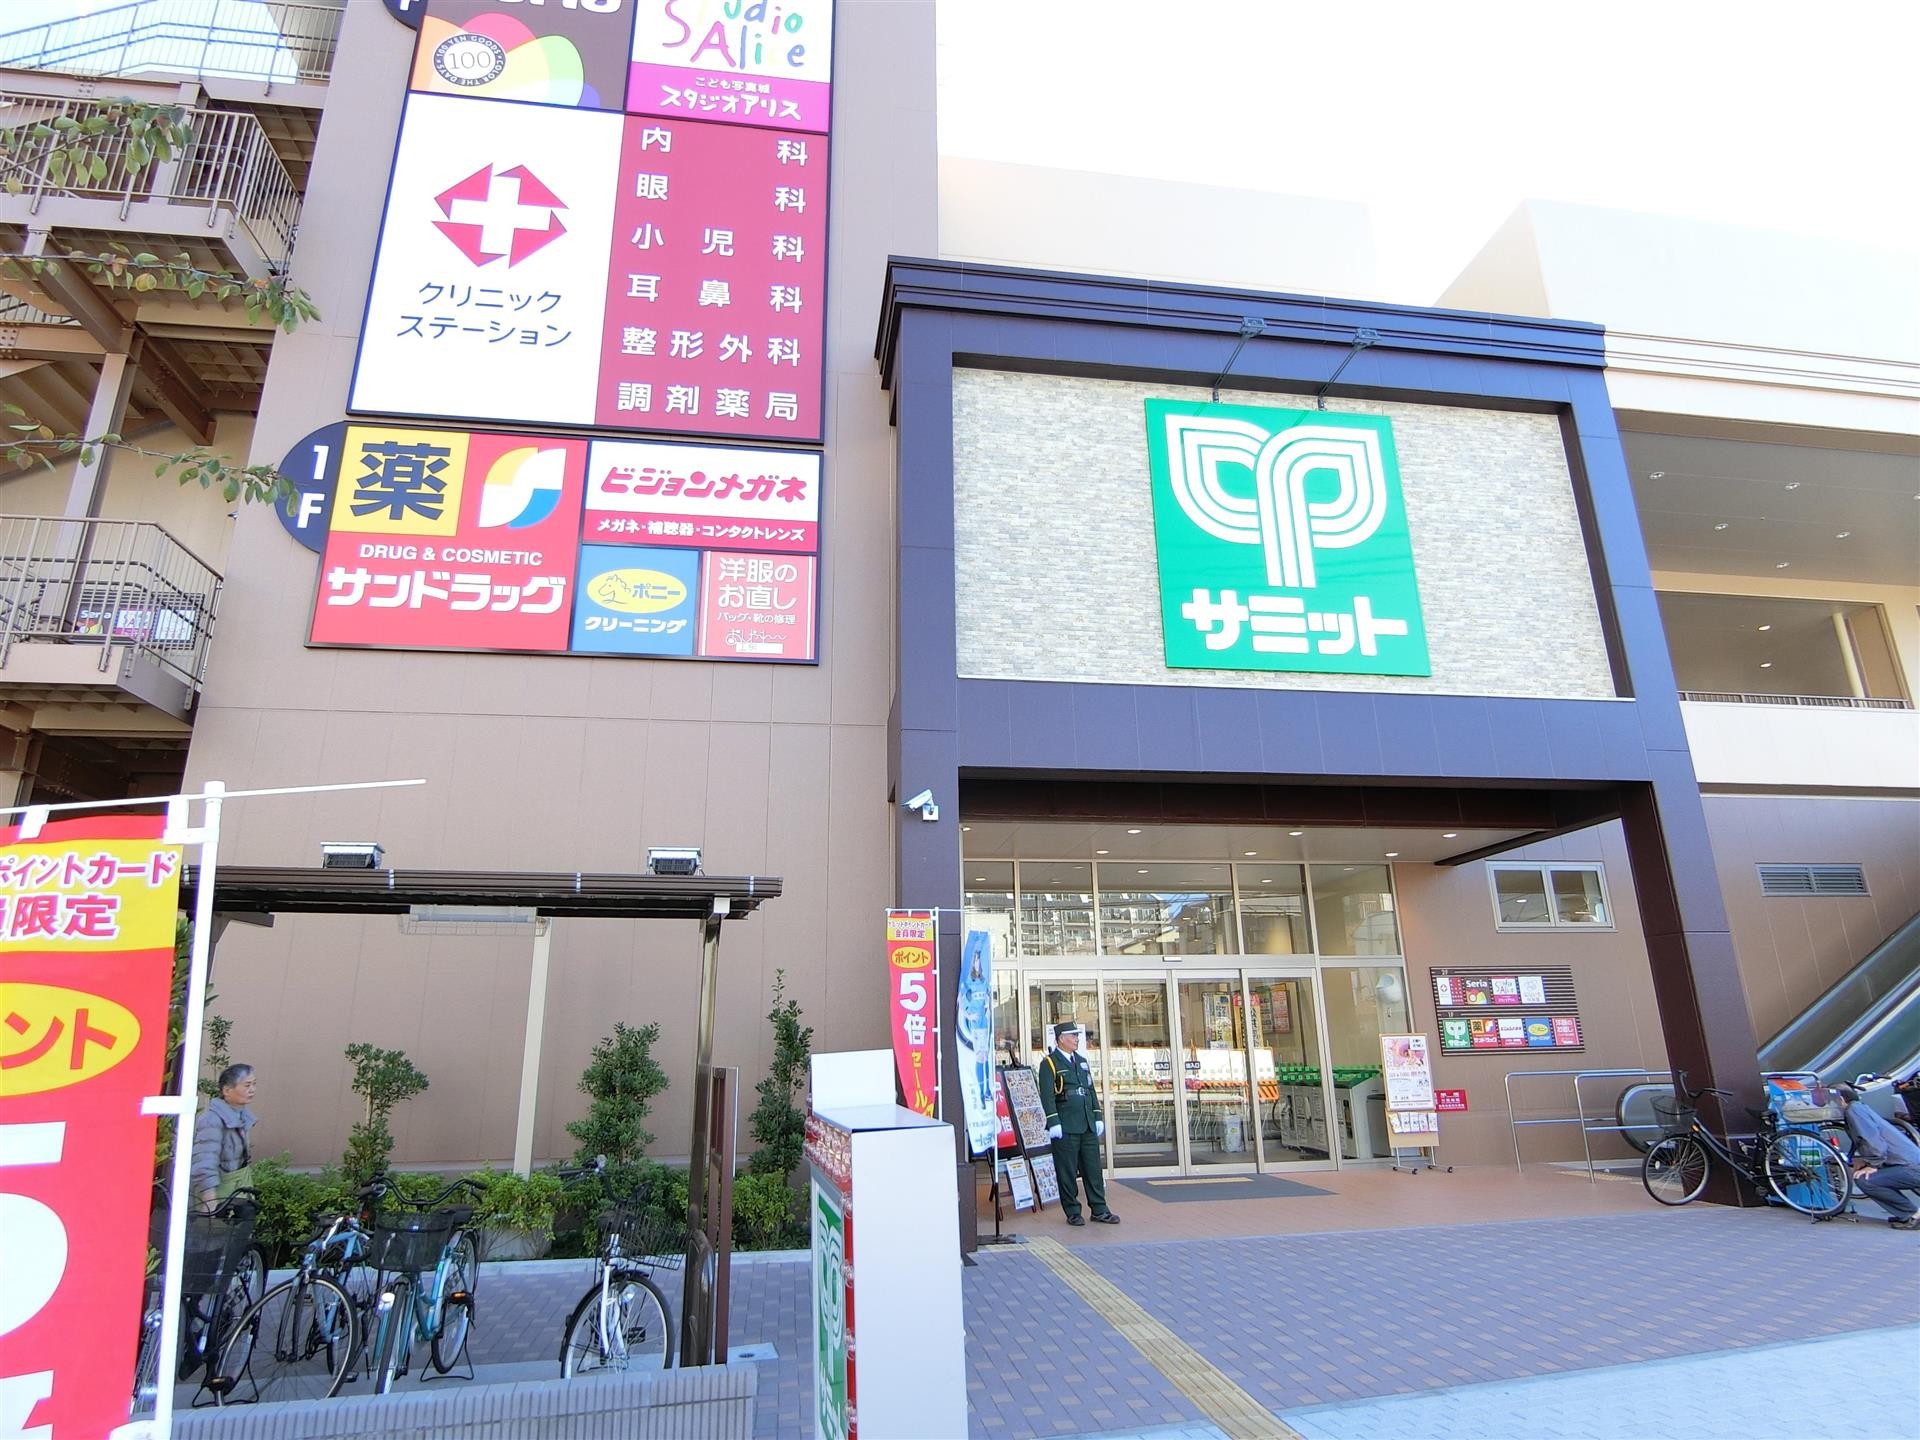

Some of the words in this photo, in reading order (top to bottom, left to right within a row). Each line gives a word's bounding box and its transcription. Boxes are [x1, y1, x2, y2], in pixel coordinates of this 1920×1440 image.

[448, 50, 491, 70] 100
[660, 84, 802, 121] スタジオアリス
[417, 281, 563, 315] クリニック
[396, 314, 573, 348] ステーション
[620, 326, 801, 367] 整形外科
[616, 381, 799, 422] 調剤薬局
[350, 441, 452, 521] 薬
[601, 466, 808, 503] ビジョンメガネ
[359, 543, 418, 561] DRUG
[422, 546, 437, 561] &
[442, 547, 544, 567] COSMETIC
[718, 557, 798, 584] 洋服の
[326, 565, 567, 615] サンドラッグ
[631, 583, 681, 600] ポニー
[718, 583, 798, 610] お直し
[80, 609, 113, 619] Sera
[585, 616, 688, 635] クリーニング
[1181, 587, 1409, 657] サミット
[0, 895, 119, 938] 限定
[895, 951, 929, 965] ポイント
